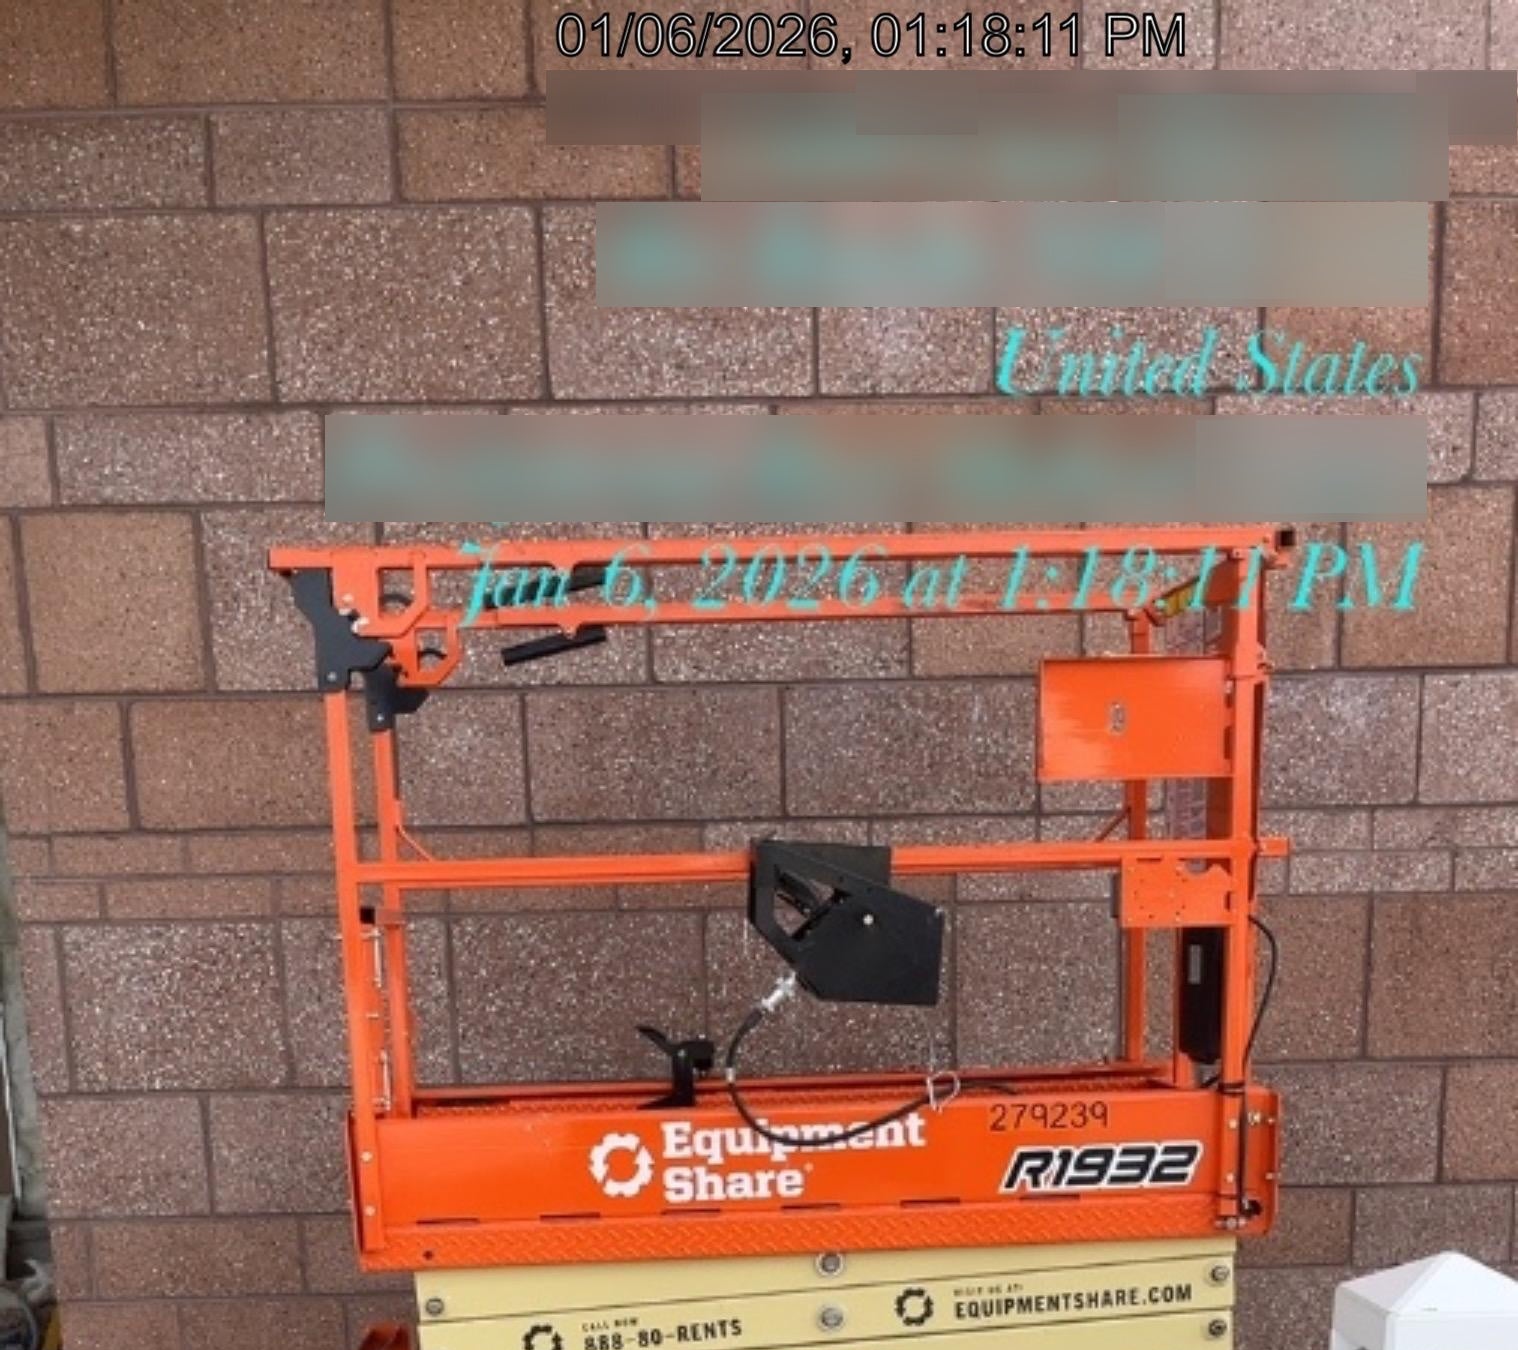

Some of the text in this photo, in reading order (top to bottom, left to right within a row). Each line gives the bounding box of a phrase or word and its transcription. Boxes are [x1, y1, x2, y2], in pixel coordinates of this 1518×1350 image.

[989, 1101, 1109, 1132] 279239
[661, 1111, 926, 1165] Equipment
[662, 1165, 805, 1203] Share
[1000, 1141, 1202, 1193] R1932
[954, 1283, 1193, 1320] EQUIPMENTSHARE.COM
